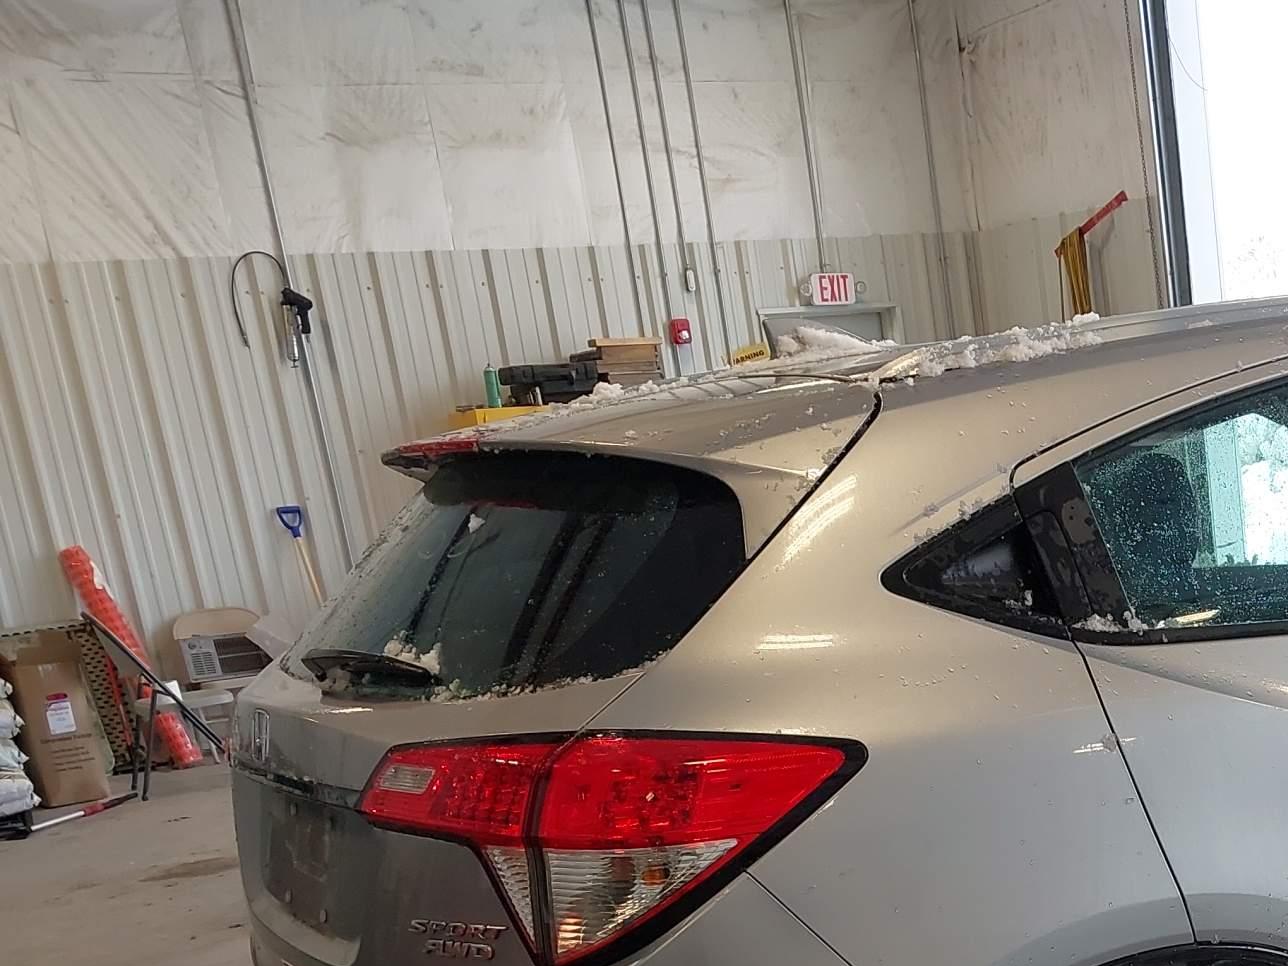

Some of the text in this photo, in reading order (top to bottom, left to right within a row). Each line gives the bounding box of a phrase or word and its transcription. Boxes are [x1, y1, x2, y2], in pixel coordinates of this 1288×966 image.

[818, 274, 849, 303] EXIT
[732, 349, 766, 366] ARNING
[408, 919, 508, 940] SPORT
[423, 939, 495, 961] AWD
